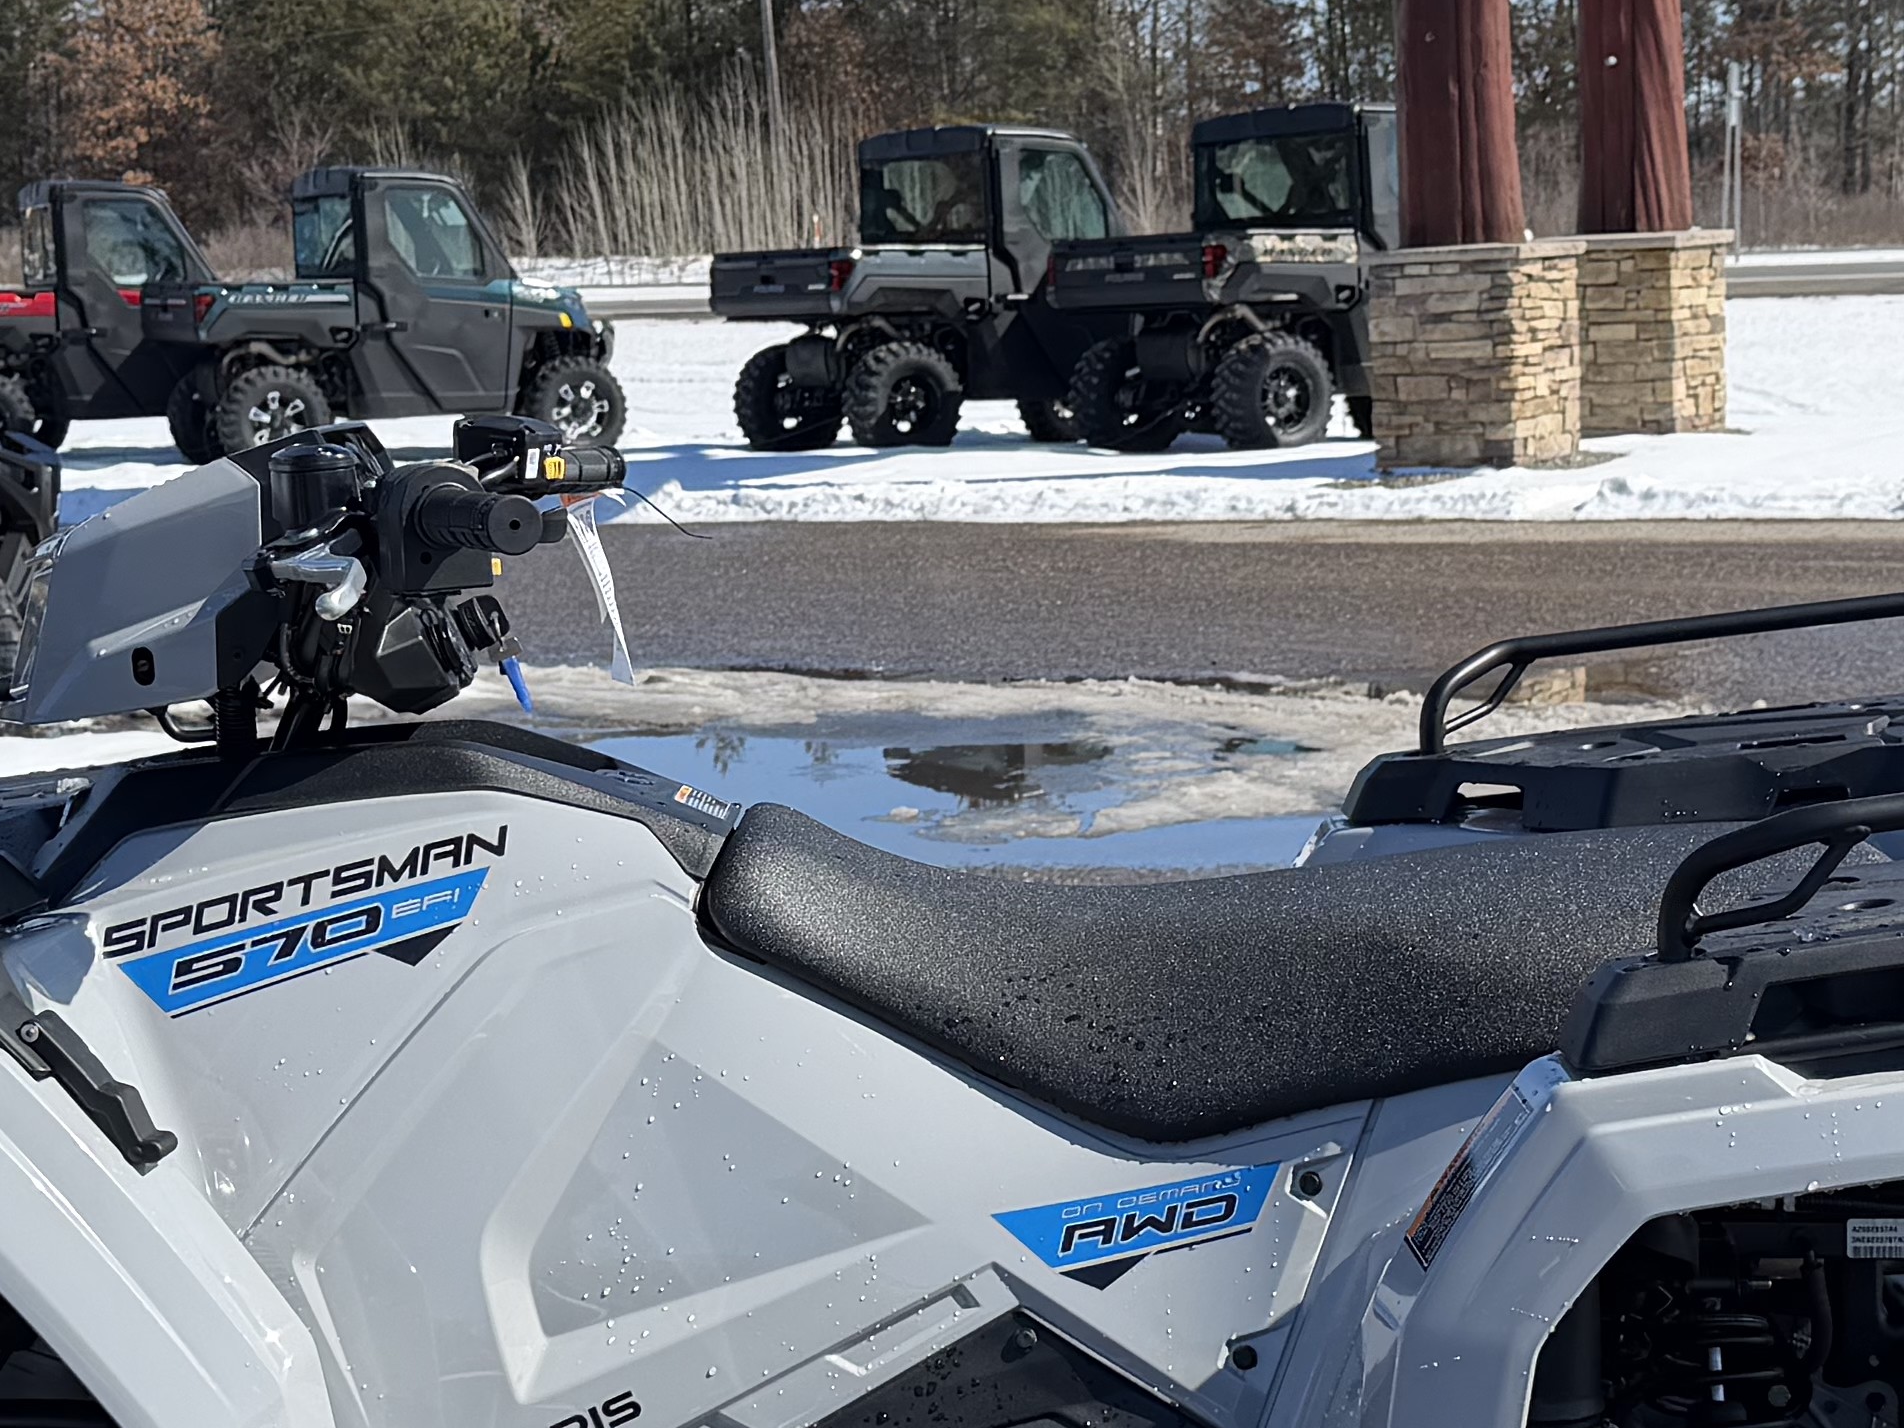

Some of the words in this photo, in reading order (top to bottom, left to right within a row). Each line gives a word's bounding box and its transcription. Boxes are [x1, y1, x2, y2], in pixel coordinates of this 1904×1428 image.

[102, 824, 508, 960] SPORTSMAN
[169, 902, 384, 996] 570
[392, 887, 460, 920] EFI
[1057, 1192, 1240, 1258] AWD
